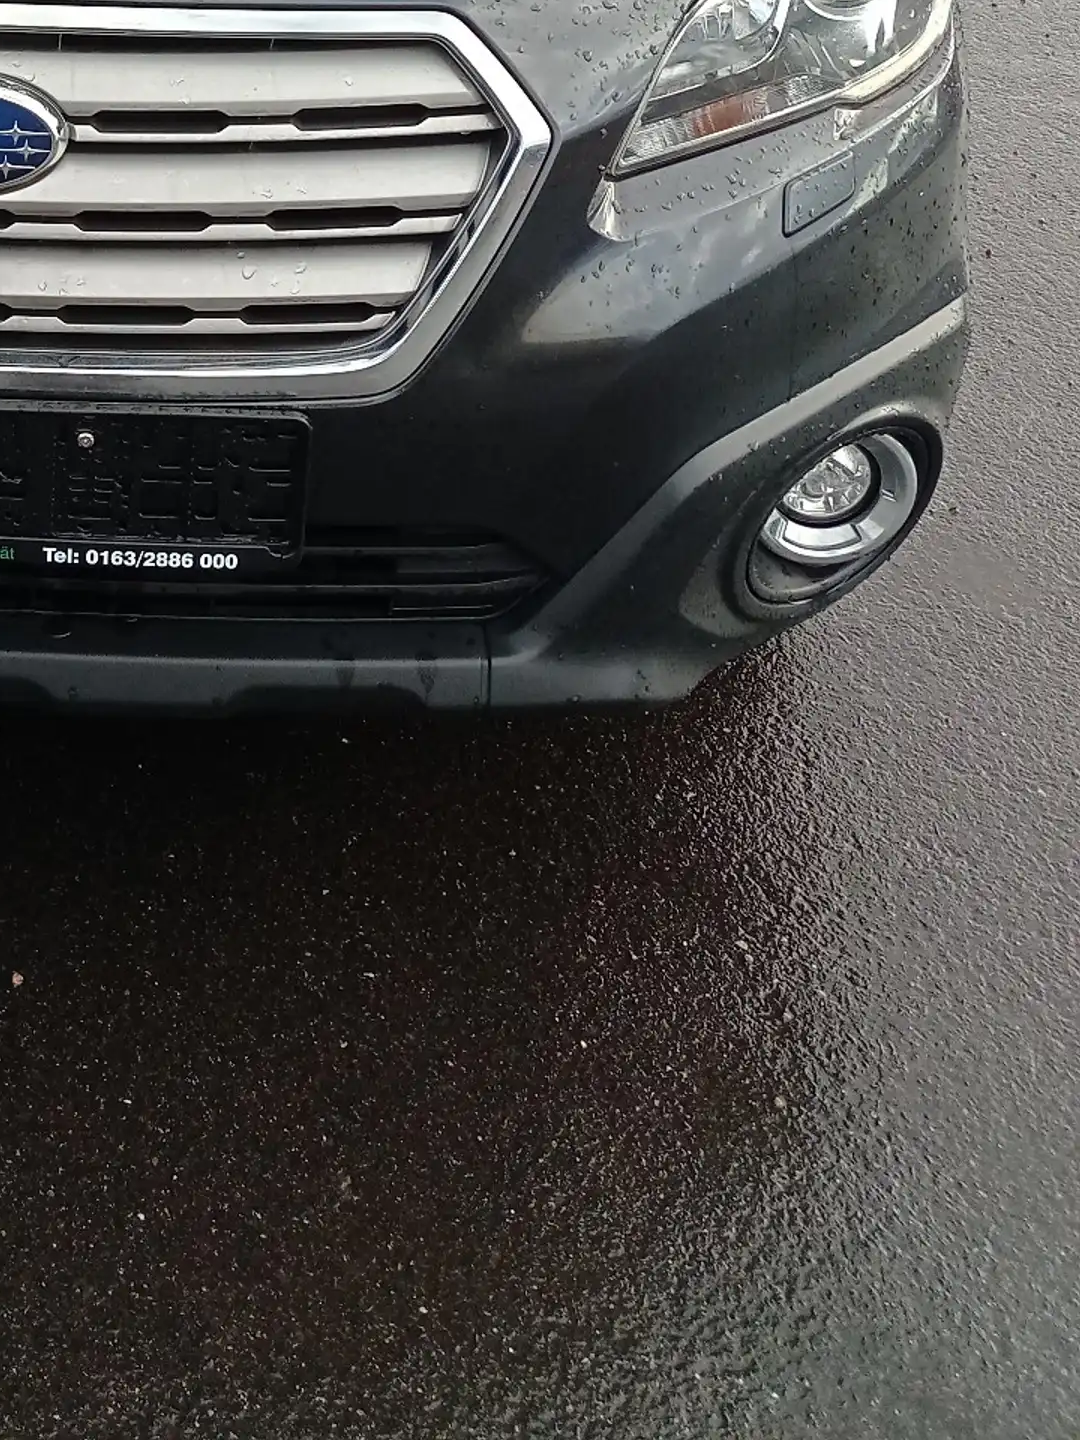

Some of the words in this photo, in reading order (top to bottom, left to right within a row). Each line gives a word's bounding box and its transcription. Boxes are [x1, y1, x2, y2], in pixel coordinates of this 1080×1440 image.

[42, 547, 79, 564] Tel:
[85, 549, 194, 569] 0163/2886
[199, 553, 239, 570] 000
